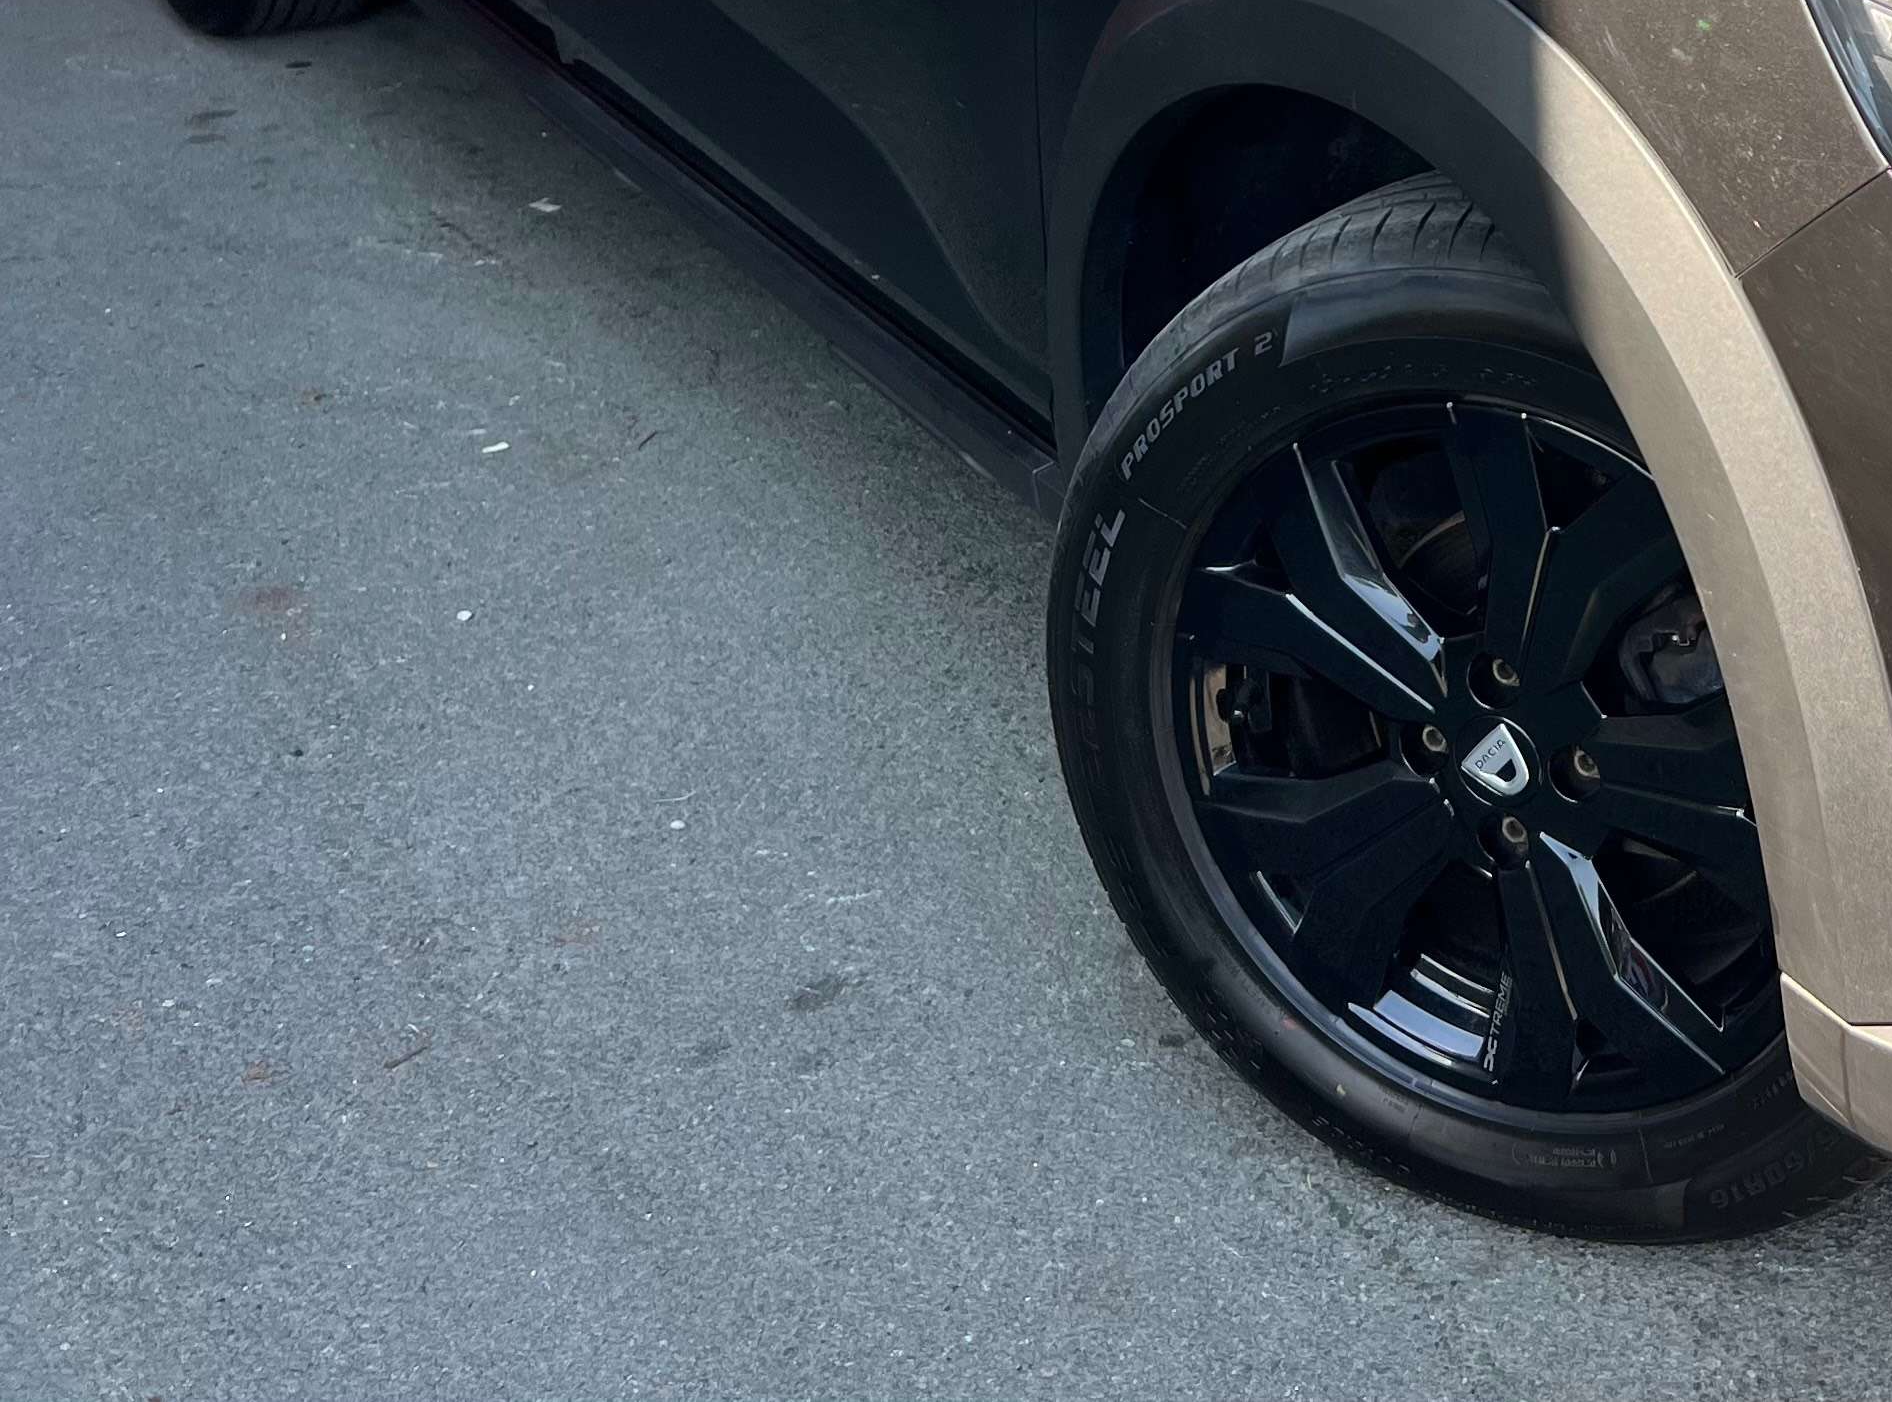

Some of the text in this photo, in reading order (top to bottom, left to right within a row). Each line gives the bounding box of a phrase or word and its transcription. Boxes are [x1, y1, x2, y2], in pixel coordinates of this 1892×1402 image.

[1121, 347, 1240, 480] PROSPORT
[1254, 331, 1273, 356] 2
[1475, 739, 1506, 770] DACIA
